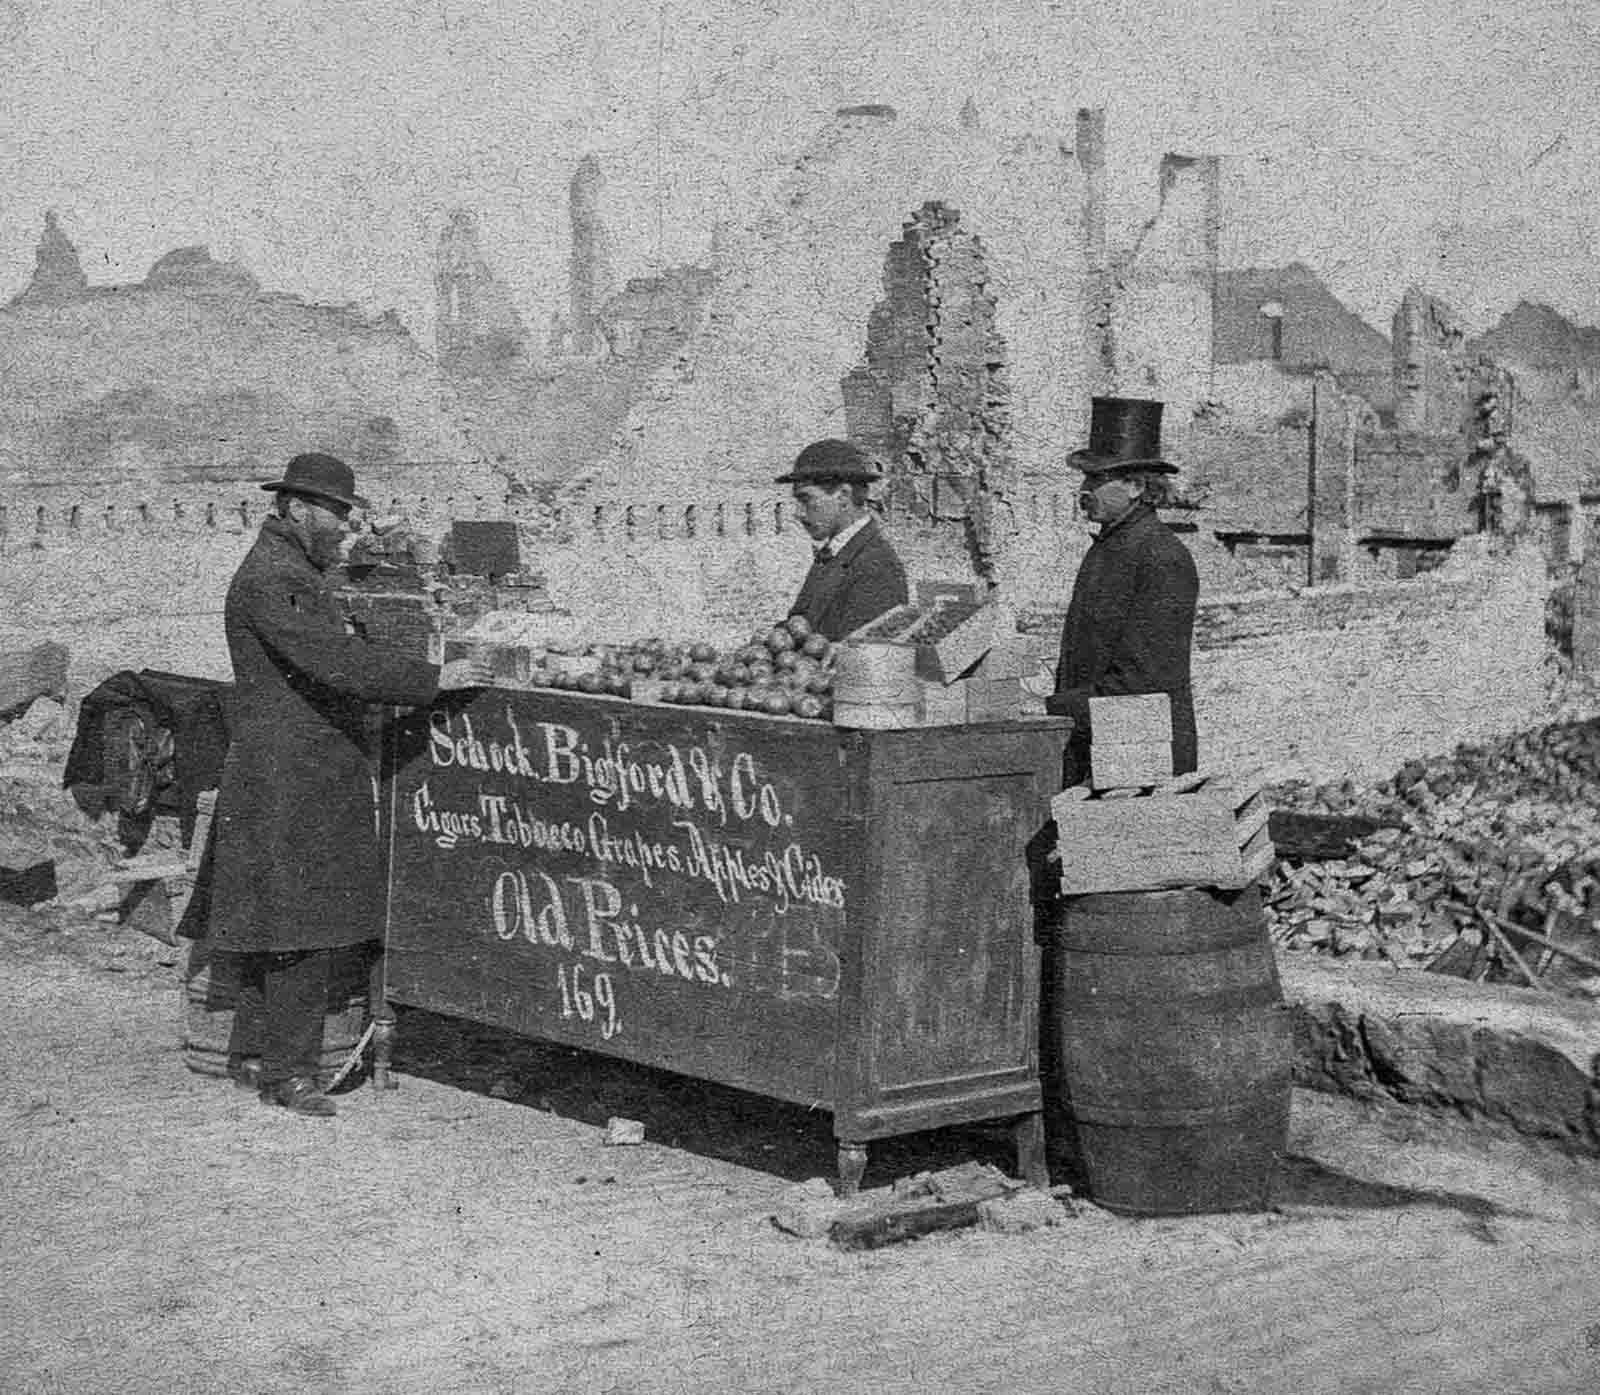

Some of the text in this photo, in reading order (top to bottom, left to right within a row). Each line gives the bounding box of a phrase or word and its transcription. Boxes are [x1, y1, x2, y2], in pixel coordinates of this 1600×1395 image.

[536, 722, 696, 811] Bigford
[731, 752, 793, 827] Co.
[672, 821, 769, 903] Apples
[492, 871, 576, 951] Old
[566, 877, 731, 988] Prices.
